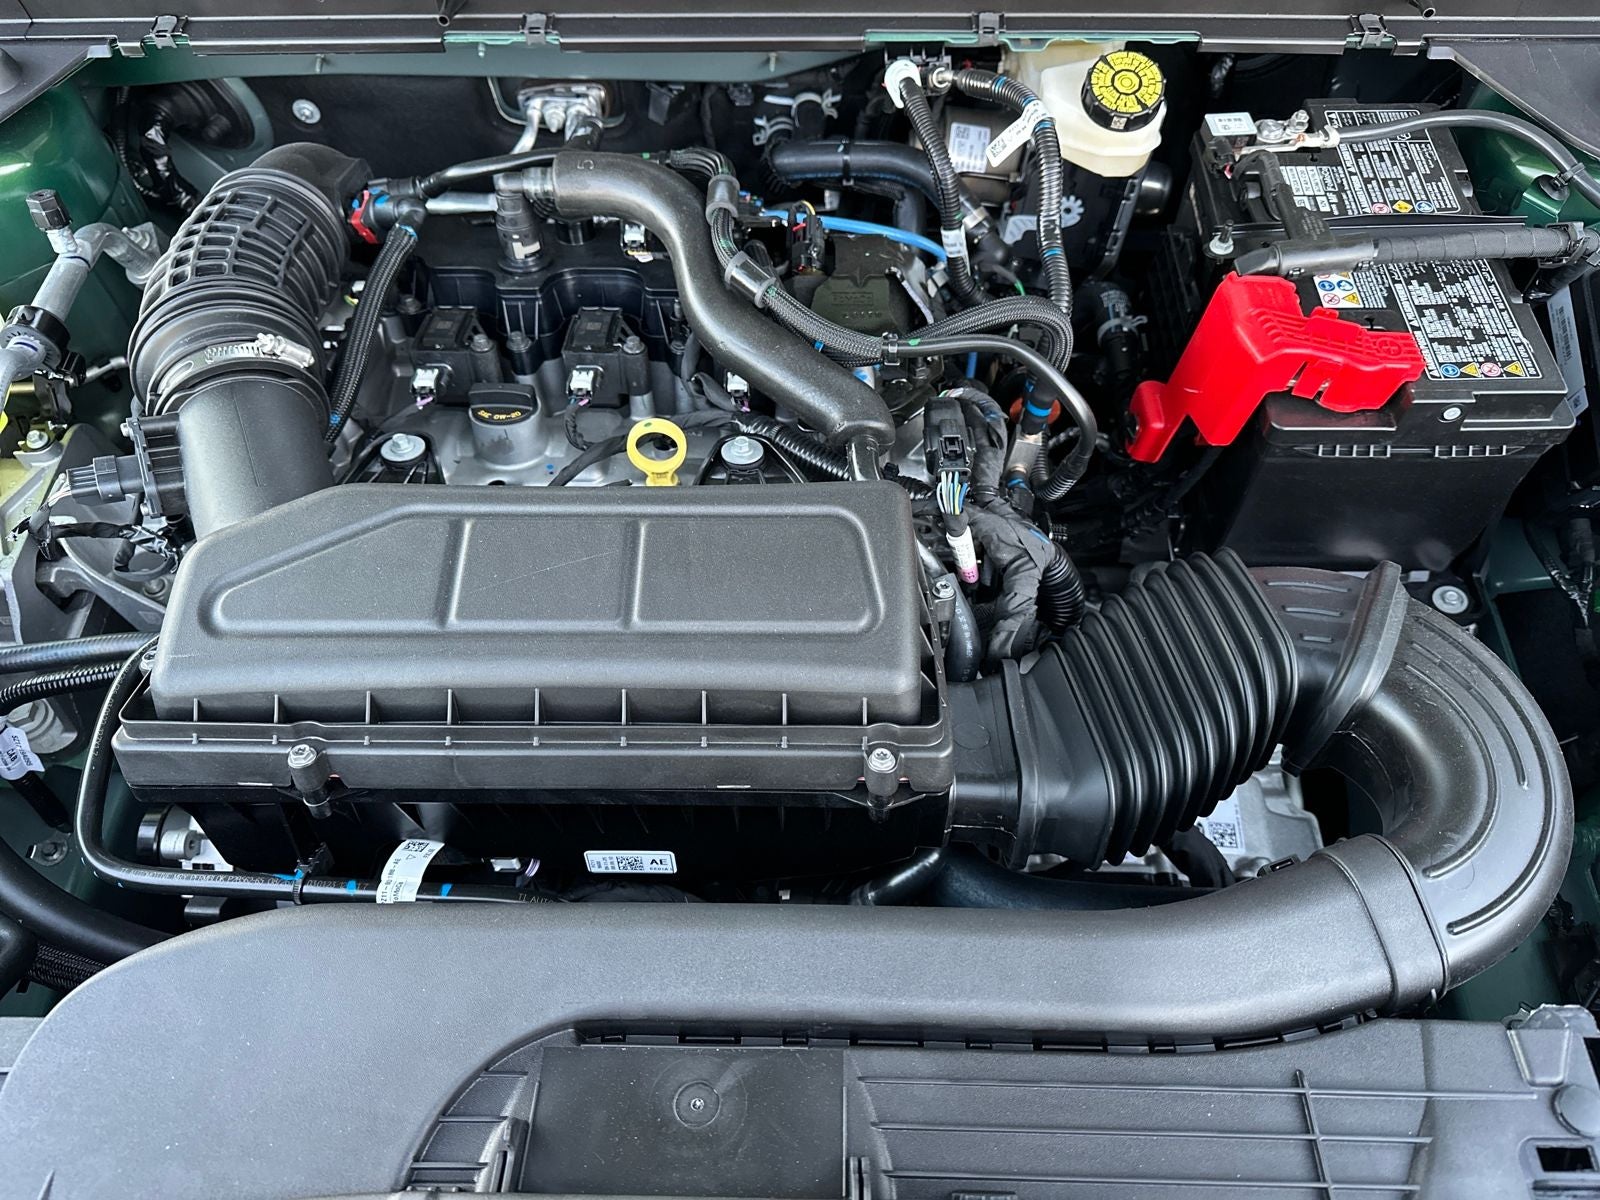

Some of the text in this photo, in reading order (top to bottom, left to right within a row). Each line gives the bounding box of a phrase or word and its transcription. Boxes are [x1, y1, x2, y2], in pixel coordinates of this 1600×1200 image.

[493, 410, 522, 420] 0W-20
[7, 749, 18, 762] CAB
[650, 858, 668, 866] AE
